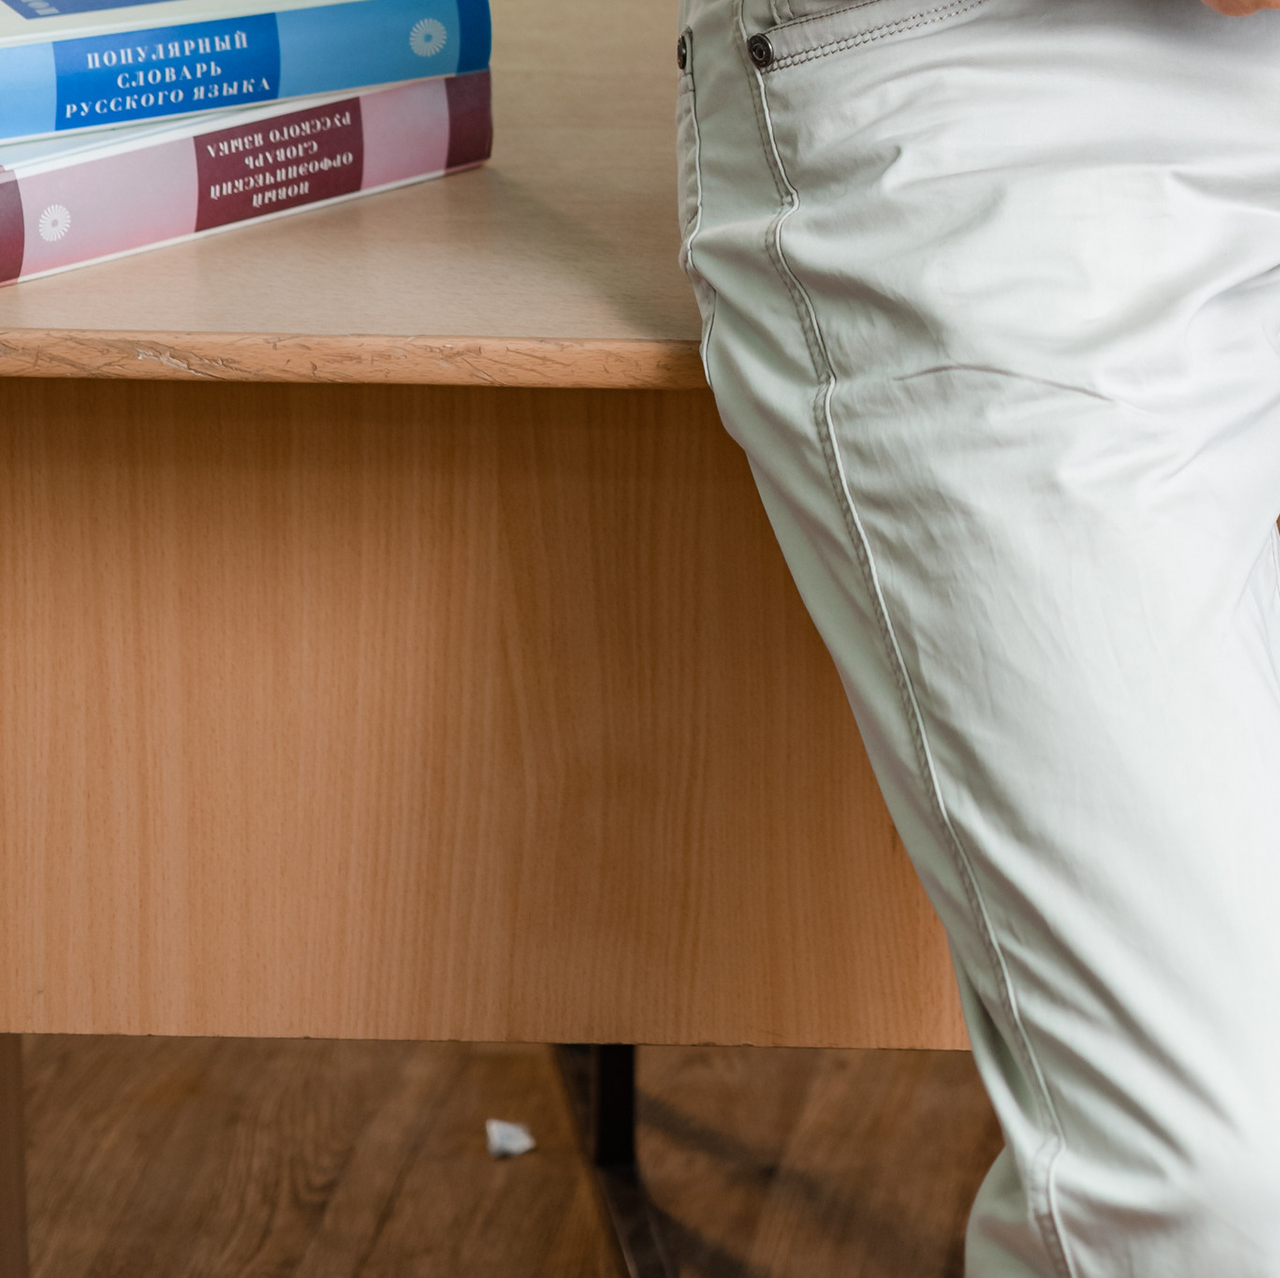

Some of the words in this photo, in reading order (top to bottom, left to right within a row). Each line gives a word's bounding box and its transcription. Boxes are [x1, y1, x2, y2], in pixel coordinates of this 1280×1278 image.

[87, 29, 249, 70] ПОПУЛЯРНЫЙ
[116, 60, 222, 90] СЛОВАРЬ
[65, 88, 184, 119] РУССКОГО
[193, 76, 270, 101] ЯЗЫКА
[268, 110, 352, 144] РУССКОГО
[206, 132, 264, 158] ЯЗЫКА
[244, 140, 318, 170] СЛОВАРЬ
[209, 151, 354, 200] ОРФОЭПИЧЕСКИЙ
[252, 180, 310, 208] НОВЫЙ
